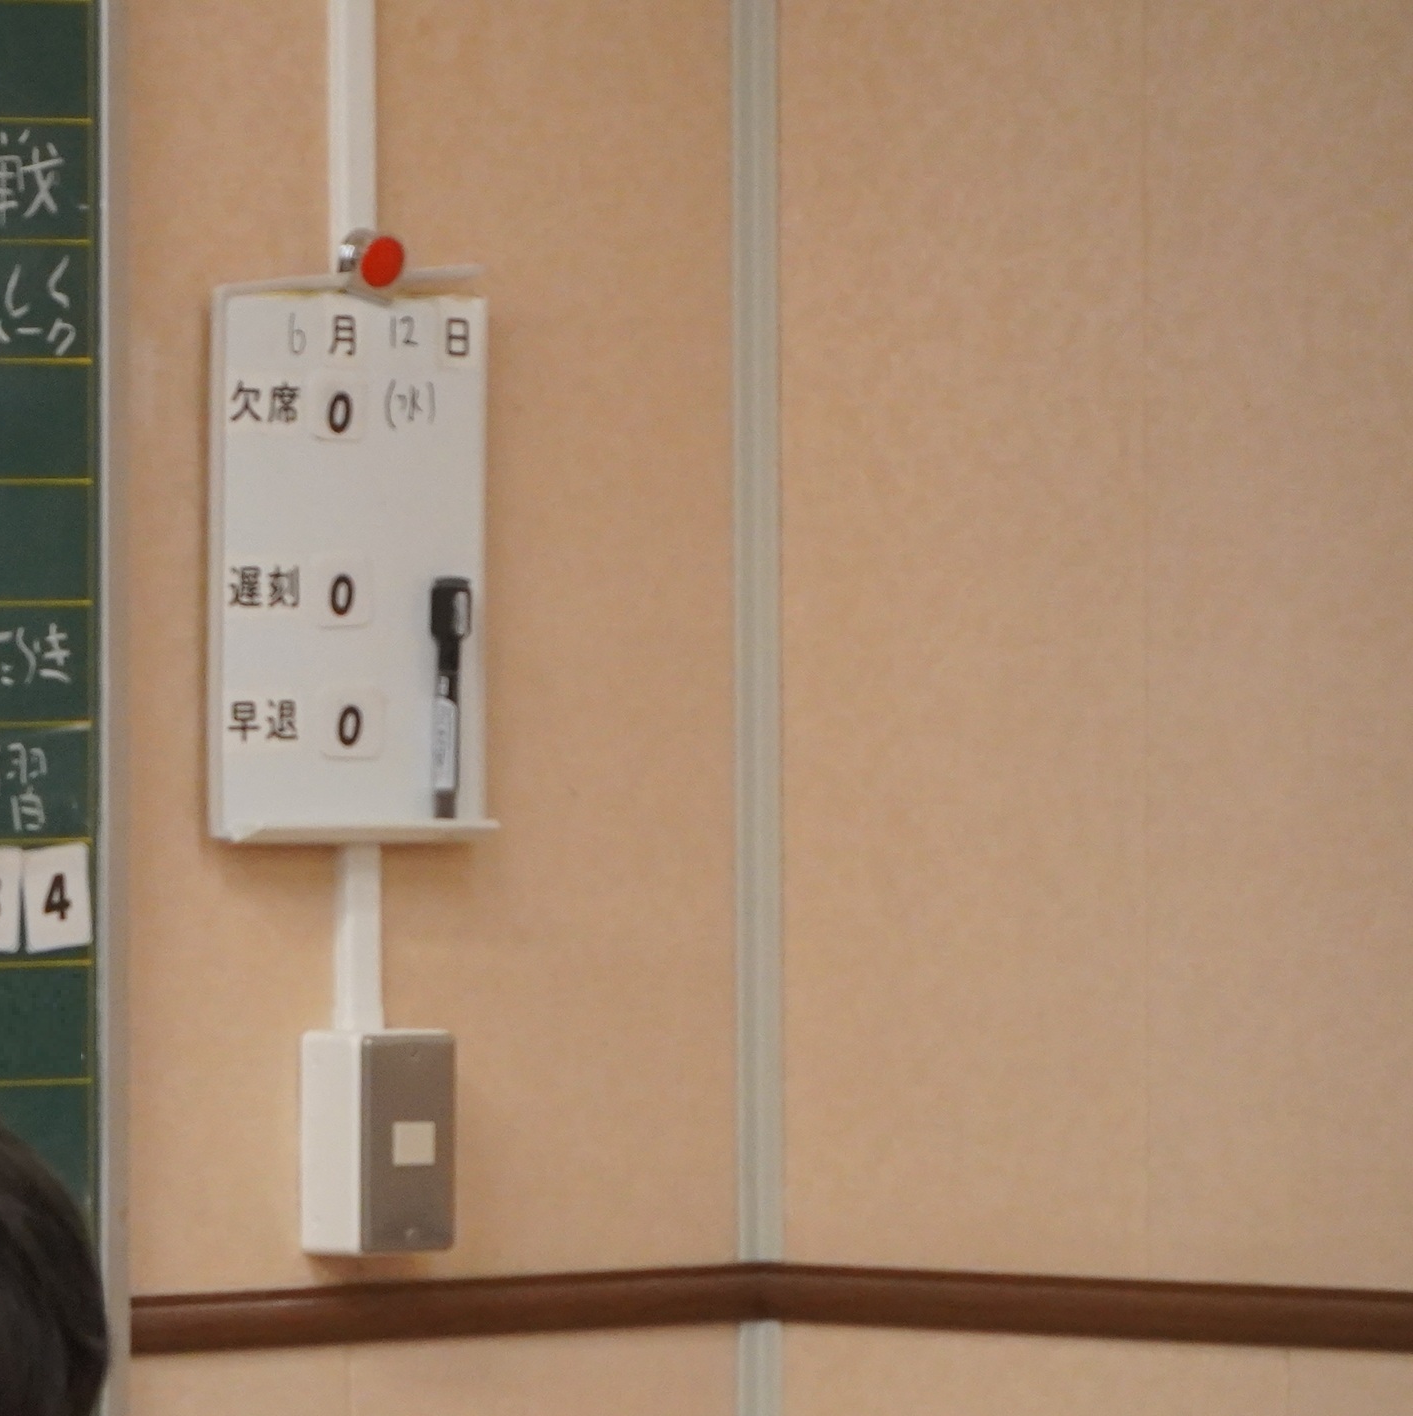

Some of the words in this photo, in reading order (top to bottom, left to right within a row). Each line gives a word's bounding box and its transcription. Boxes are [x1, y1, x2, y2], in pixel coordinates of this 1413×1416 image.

[230, 380, 298, 423] 欠席
[229, 566, 300, 608] 遅刻
[228, 699, 298, 742] 早退
[43, 873, 70, 920] 4
